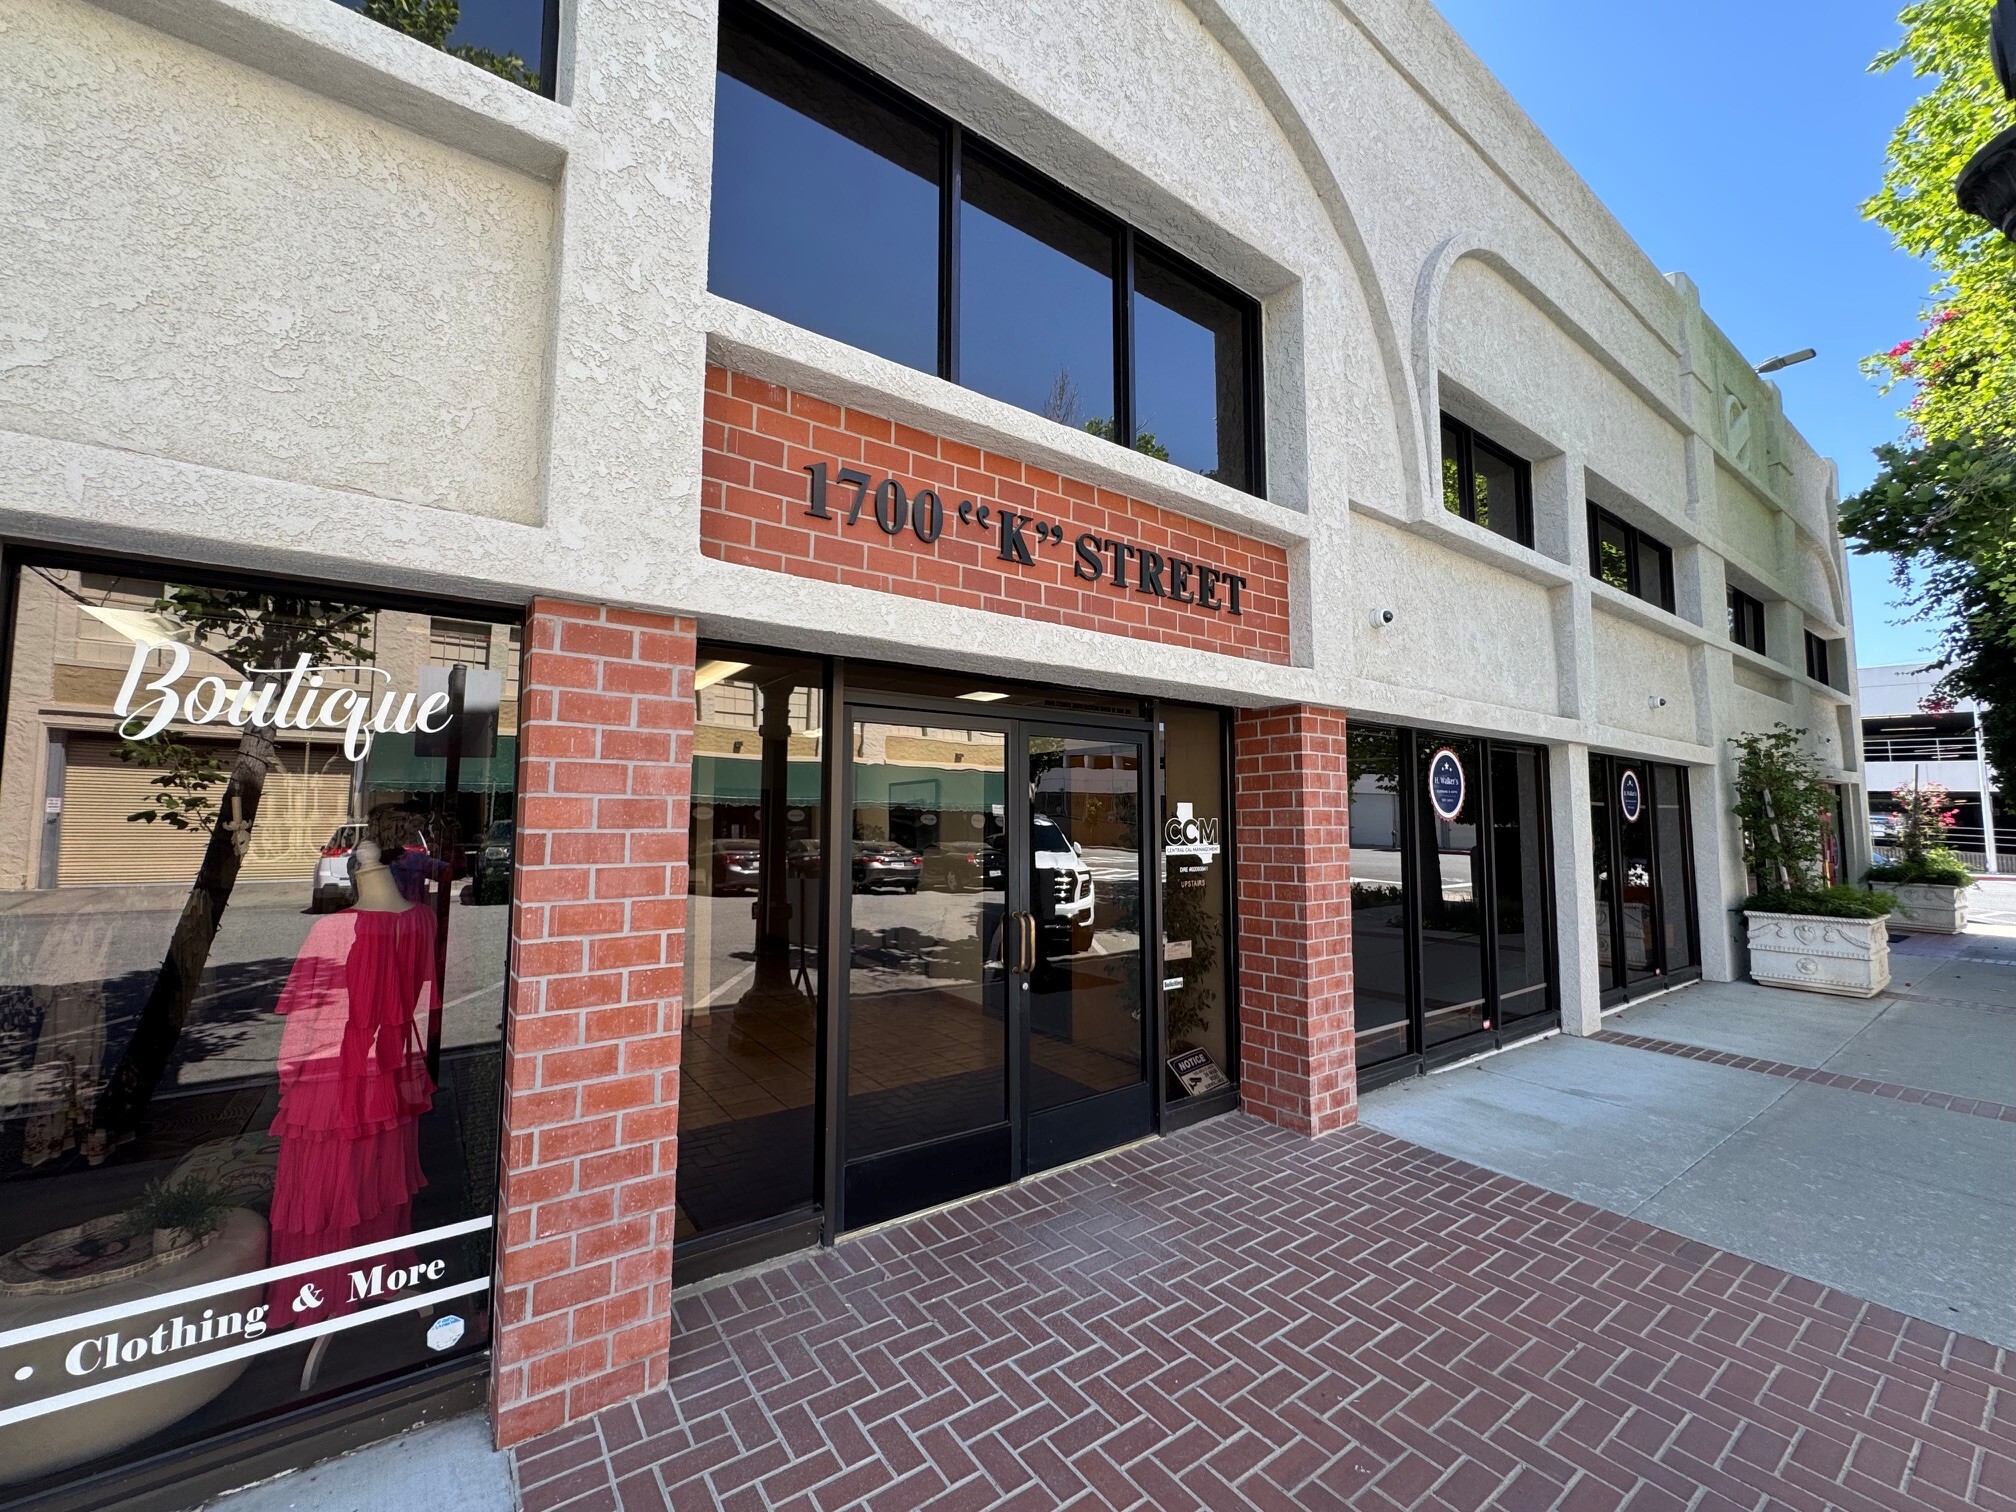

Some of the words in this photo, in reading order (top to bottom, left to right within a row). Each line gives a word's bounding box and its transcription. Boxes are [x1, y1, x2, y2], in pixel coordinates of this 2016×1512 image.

[803, 462, 943, 544] 1700
[1074, 532, 1247, 616] STREET
[113, 638, 453, 762] Boutique
[1165, 818, 1218, 846] CCM
[1181, 880, 1205, 888] UPSTAIRS
[1178, 1053, 1206, 1071] NOTICE
[65, 1301, 269, 1377] Clothing
[292, 1283, 324, 1312] &
[346, 1258, 446, 1302] More
